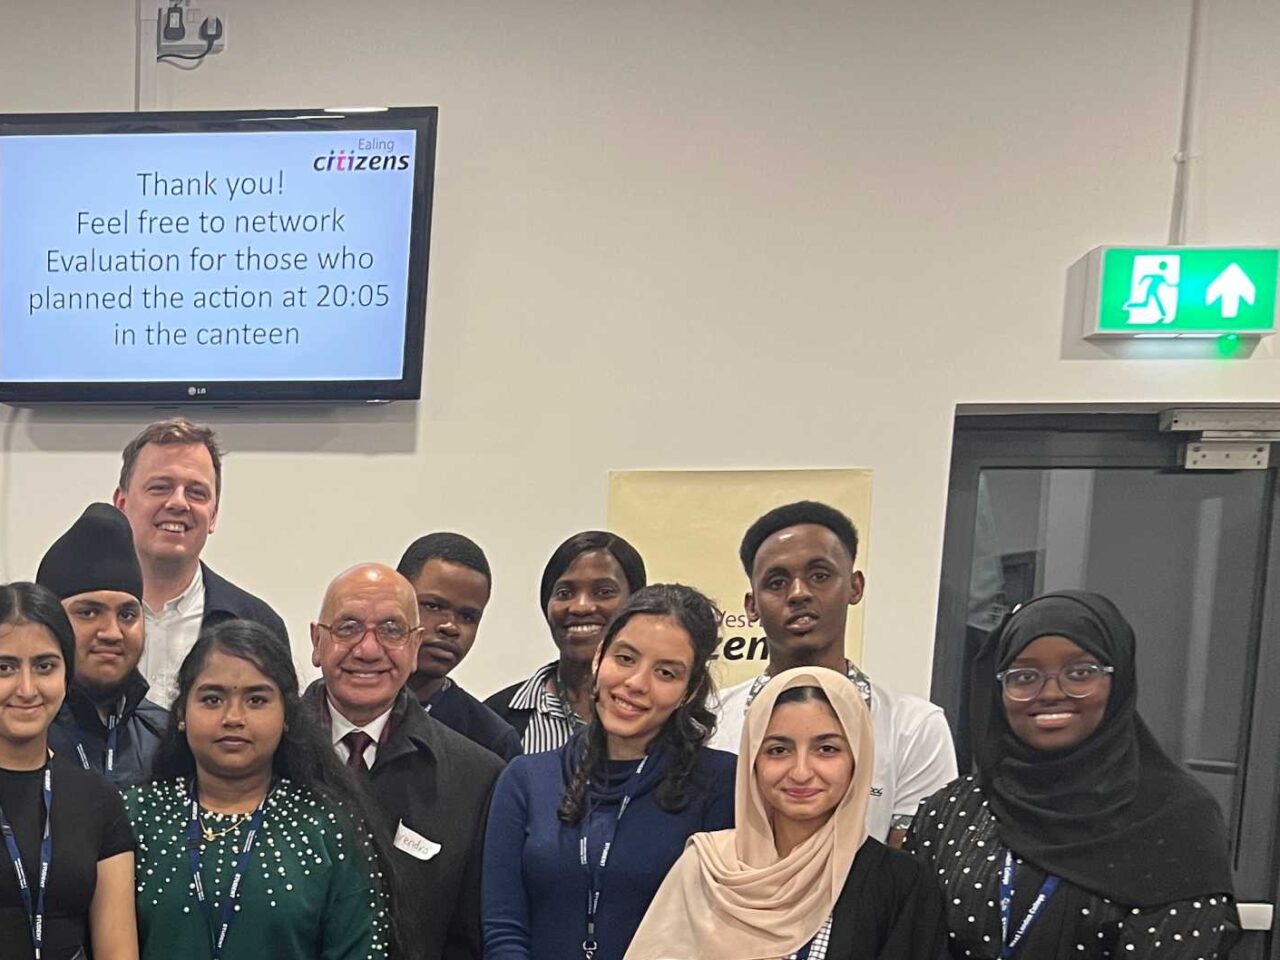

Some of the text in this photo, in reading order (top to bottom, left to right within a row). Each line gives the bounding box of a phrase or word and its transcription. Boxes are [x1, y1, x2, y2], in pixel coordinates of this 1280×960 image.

[359, 138, 395, 152] Ealing
[313, 149, 410, 171] citizens
[136, 169, 284, 201] Thank you!
[77, 207, 345, 235] Feel free to network
[46, 245, 374, 272] Evaluation for those who
[29, 284, 389, 316] planned the action at 20:05
[114, 321, 300, 346] in the canteen
[35, 914, 43, 942] STUDENT
